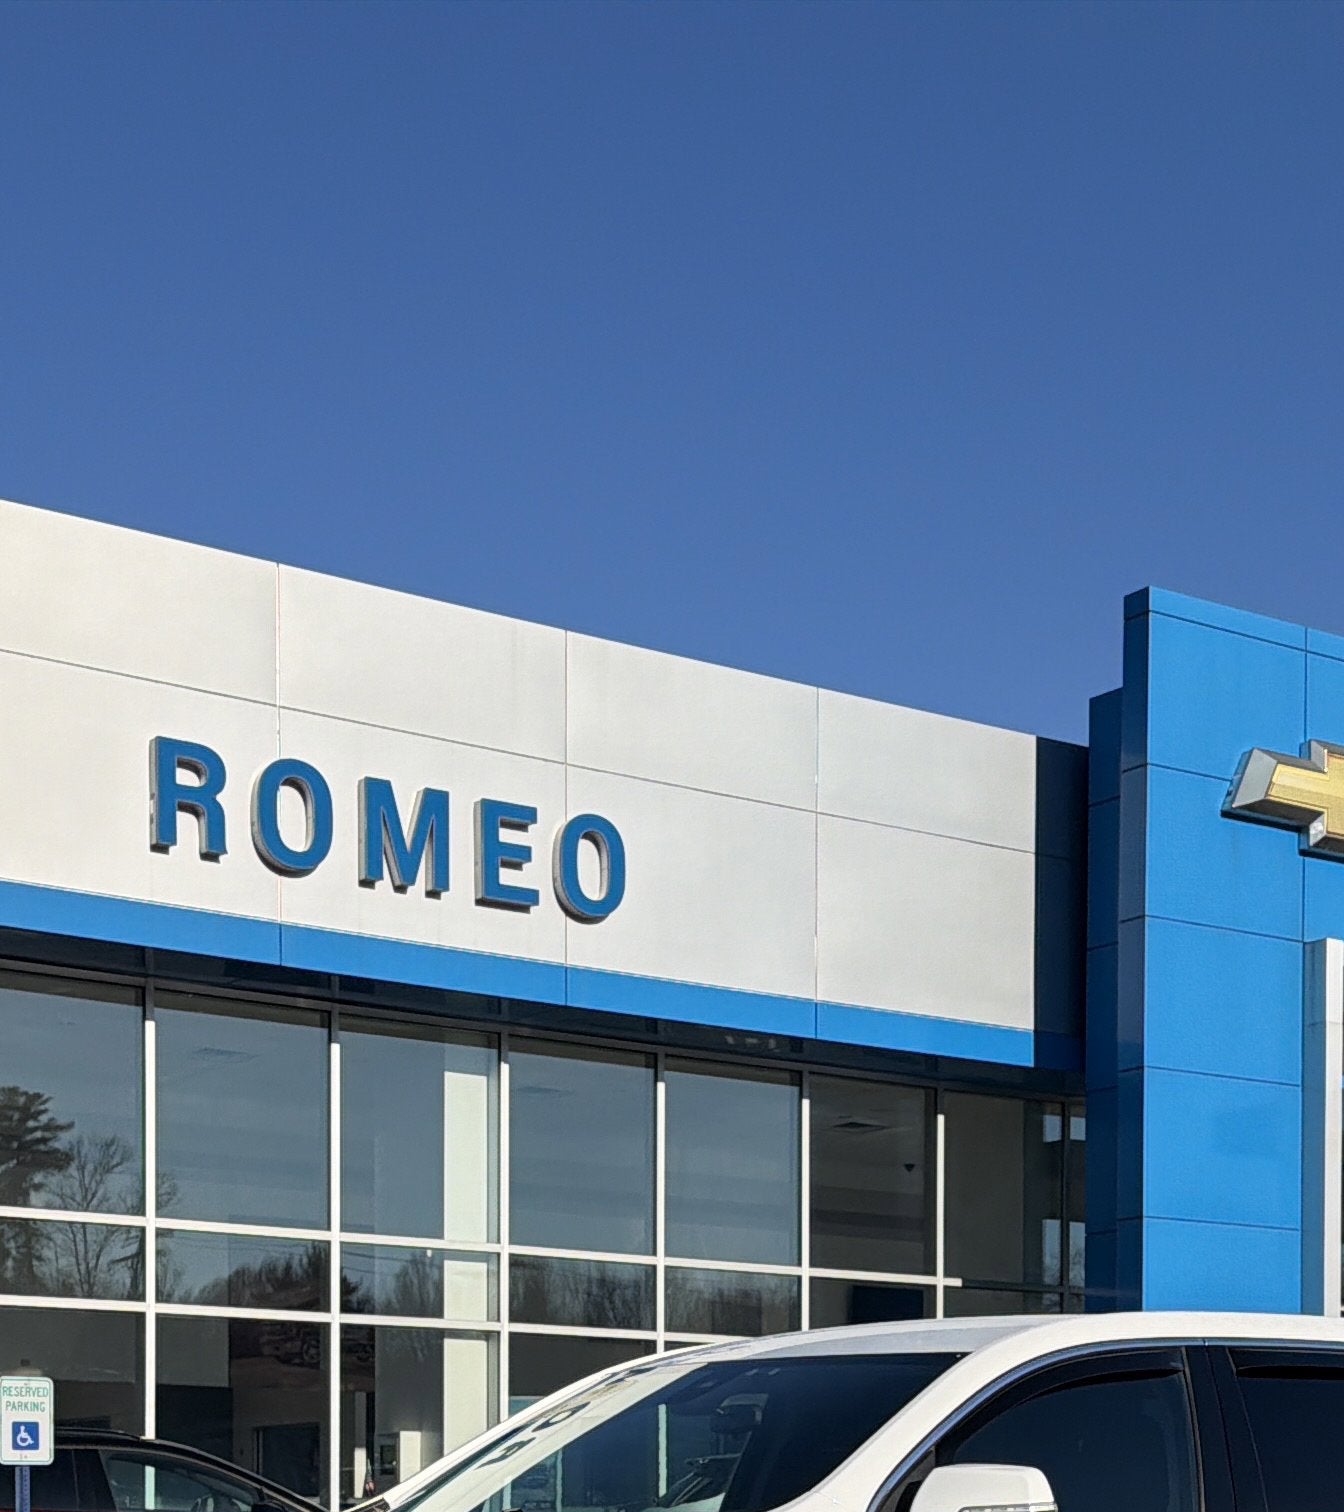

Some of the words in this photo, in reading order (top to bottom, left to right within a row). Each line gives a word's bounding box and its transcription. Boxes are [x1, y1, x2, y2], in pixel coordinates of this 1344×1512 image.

[148, 734, 626, 924] ROMEO
[1, 1385, 49, 1398] RESERVED
[5, 1400, 46, 1413] PARKING
